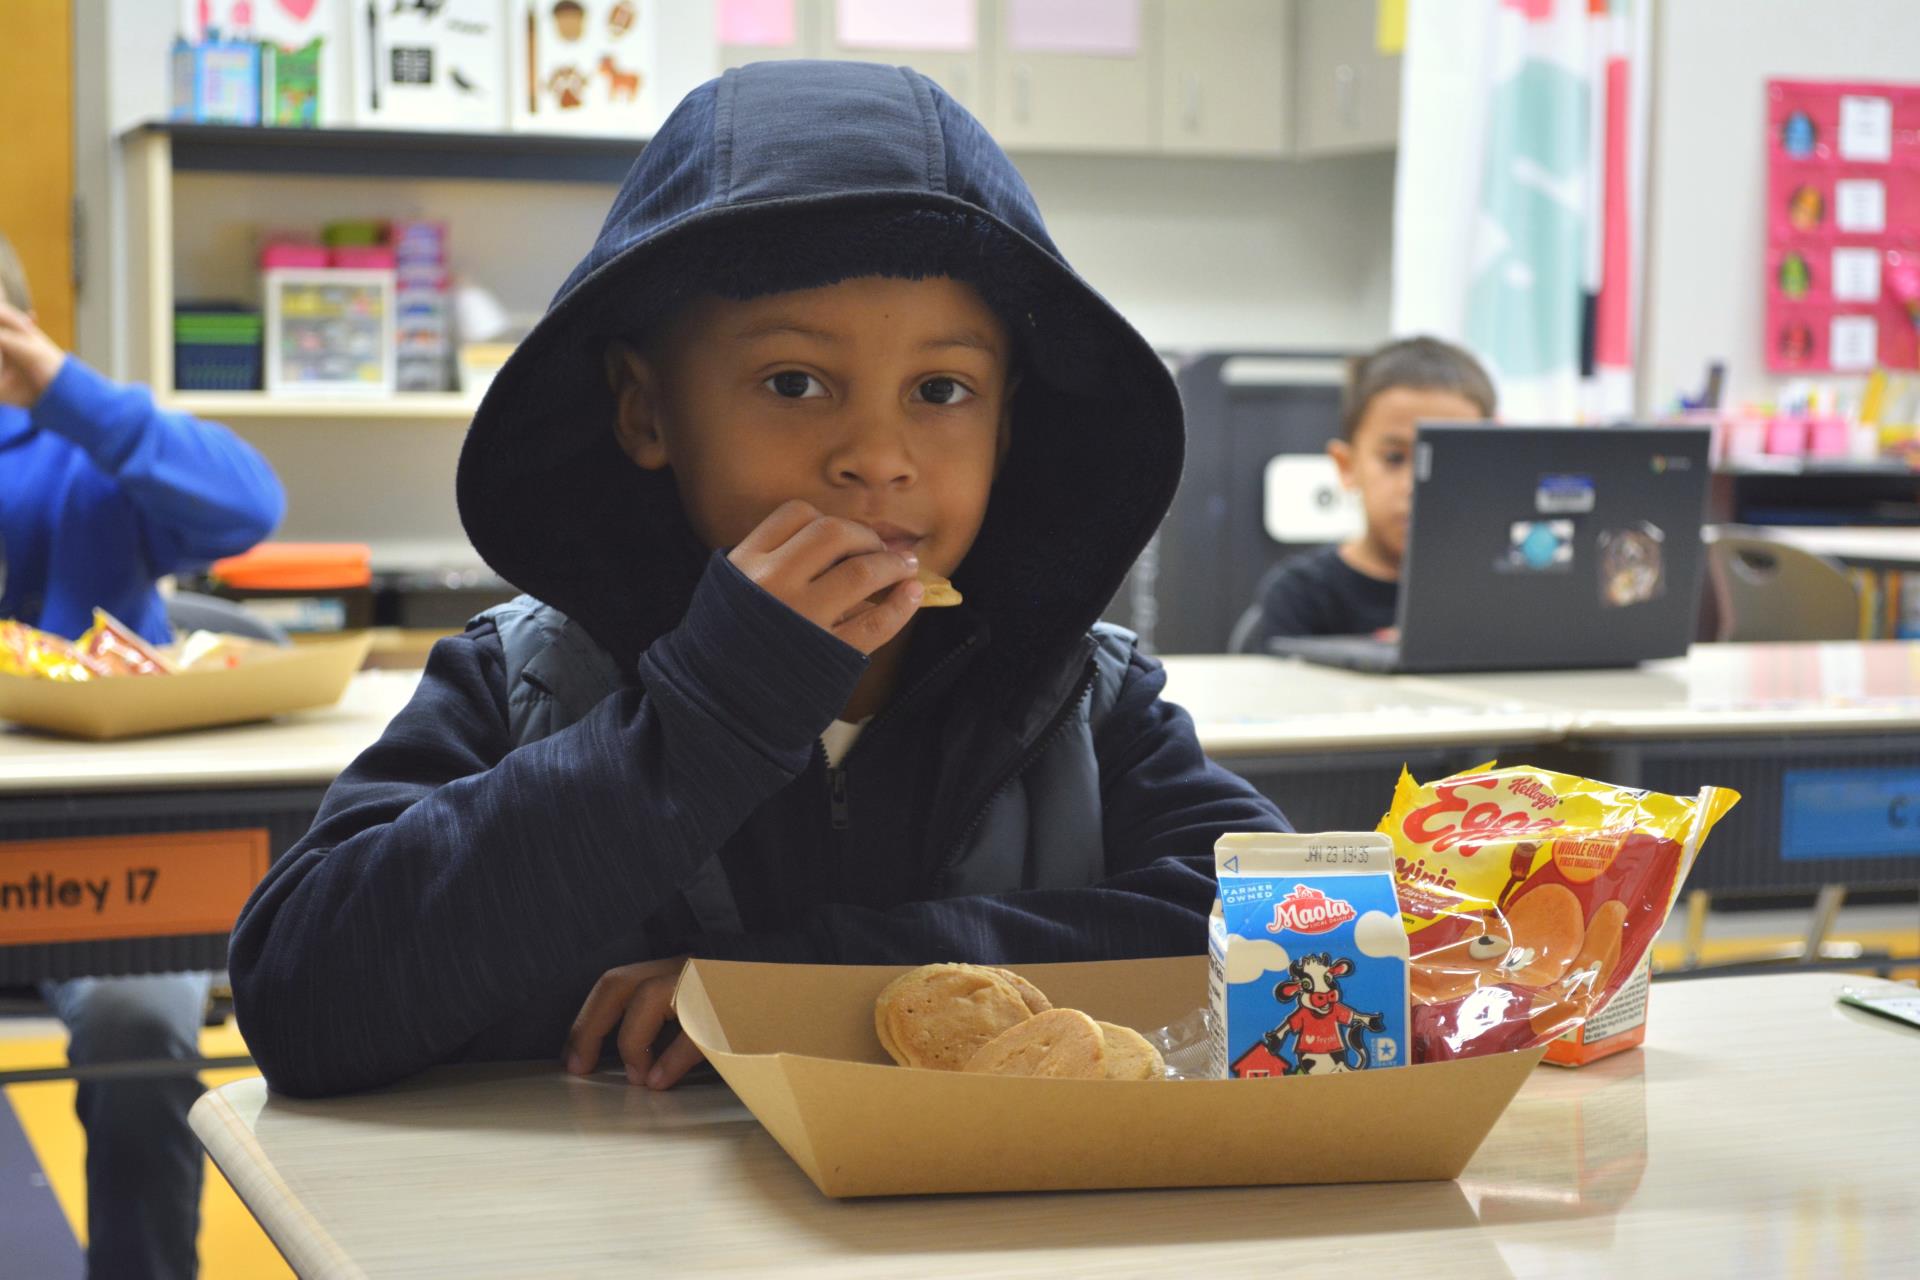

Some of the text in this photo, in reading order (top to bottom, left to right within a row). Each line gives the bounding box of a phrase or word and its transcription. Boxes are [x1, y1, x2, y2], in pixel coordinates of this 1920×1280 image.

[1508, 778, 1559, 810] Kellogg's
[1304, 845, 1322, 863] JAN
[1326, 845, 1338, 863] 23
[1559, 841, 1615, 860] WHOLE GRAIN
[0, 870, 110, 915] ntley
[1223, 884, 1273, 896] FARMER
[1226, 892, 1273, 904] OWNED
[1268, 900, 1350, 932] Maola
